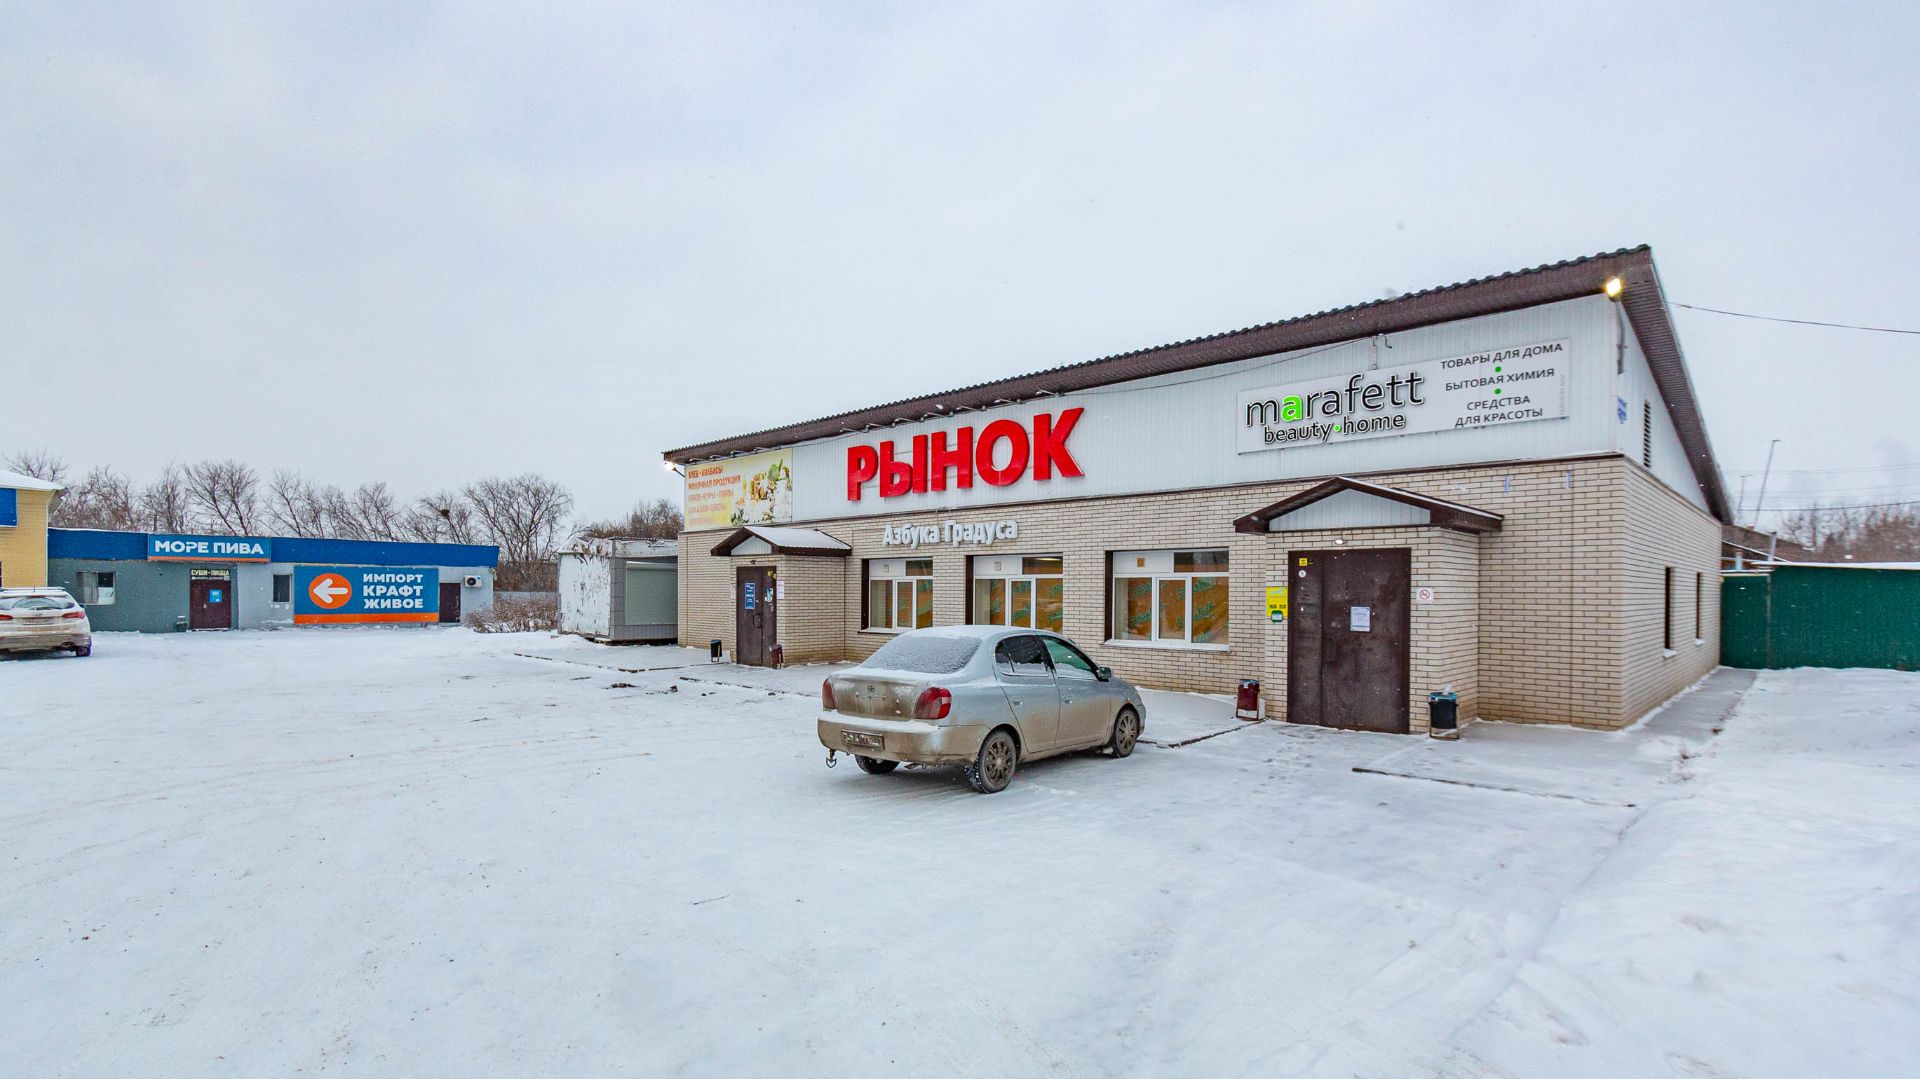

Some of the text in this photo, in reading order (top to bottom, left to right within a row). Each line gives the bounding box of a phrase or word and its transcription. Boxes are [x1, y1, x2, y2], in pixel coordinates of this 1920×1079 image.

[1440, 343, 1563, 370] ТОВАРЫ ДЛЯ ДОМА
[1445, 368, 1555, 391] БЫТОВАЯ ХИМИЯ
[1246, 371, 1425, 427] marafett
[1466, 395, 1531, 411] СРЕДСТВА
[1455, 408, 1543, 428] ДЛЯ КРАСОТЫ
[847, 407, 1085, 501] РЫНОК
[883, 519, 1019, 549] Азбука Градуса
[154, 540, 265, 555] МОРЕ ПИВА
[363, 573, 424, 583] ИМПОРТ
[363, 585, 424, 597] КРАФТ
[363, 598, 424, 609] ЖИВОЕ
